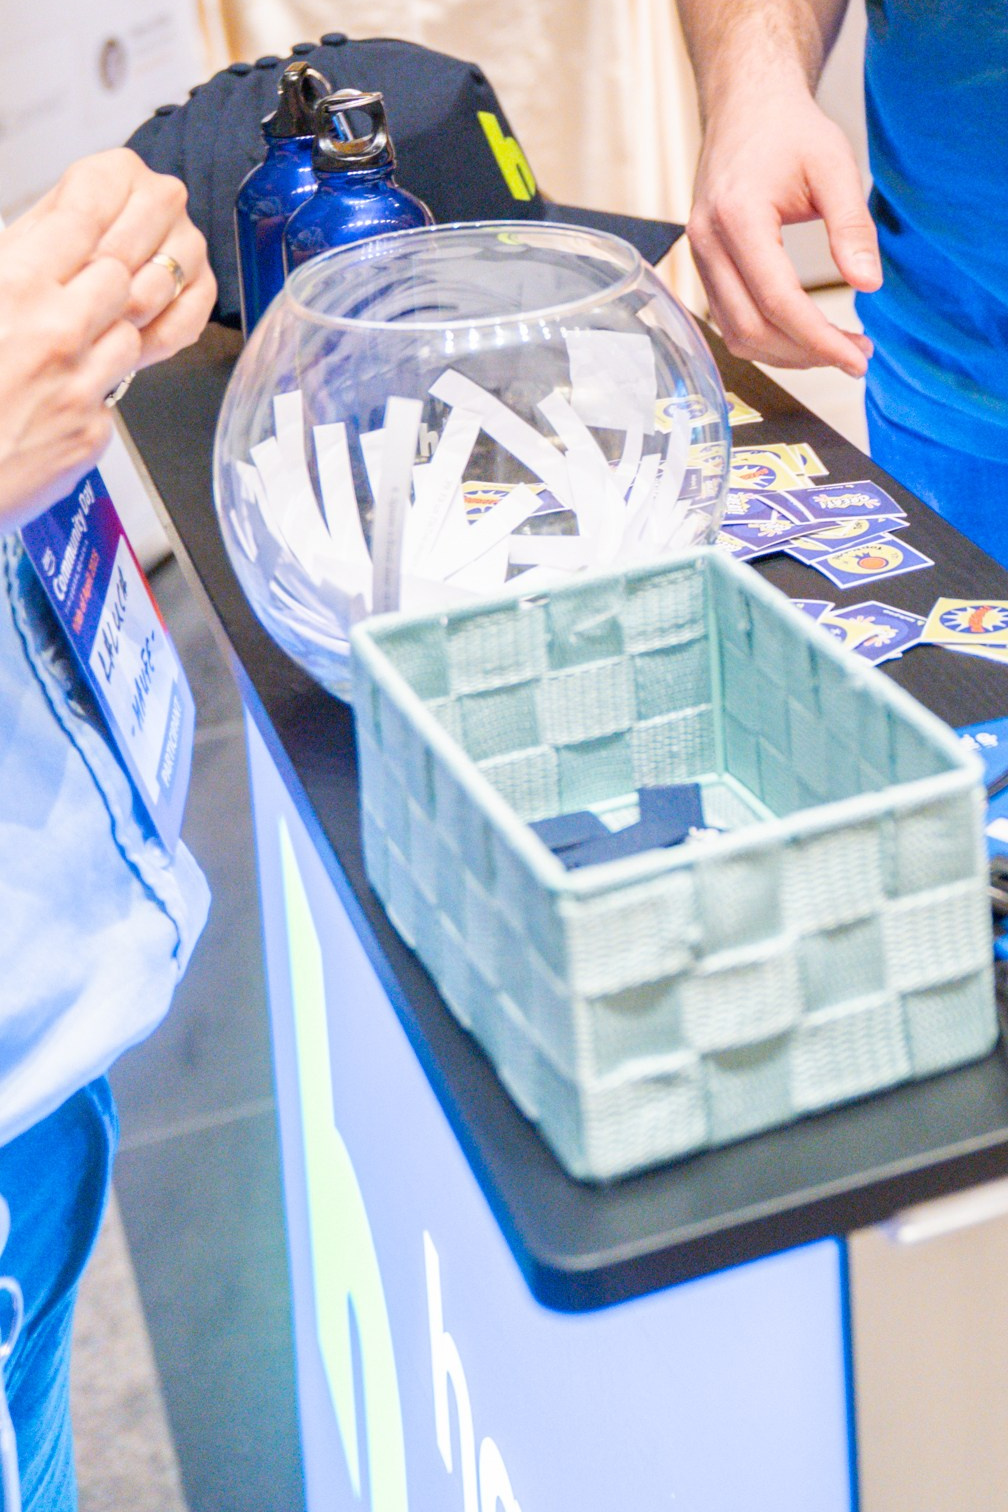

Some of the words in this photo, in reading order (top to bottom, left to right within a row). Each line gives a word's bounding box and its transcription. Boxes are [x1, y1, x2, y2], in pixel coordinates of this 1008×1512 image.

[52, 507, 88, 602] Community
[78, 479, 96, 516] Day
[161, 694, 183, 789] PARTICIPANT
